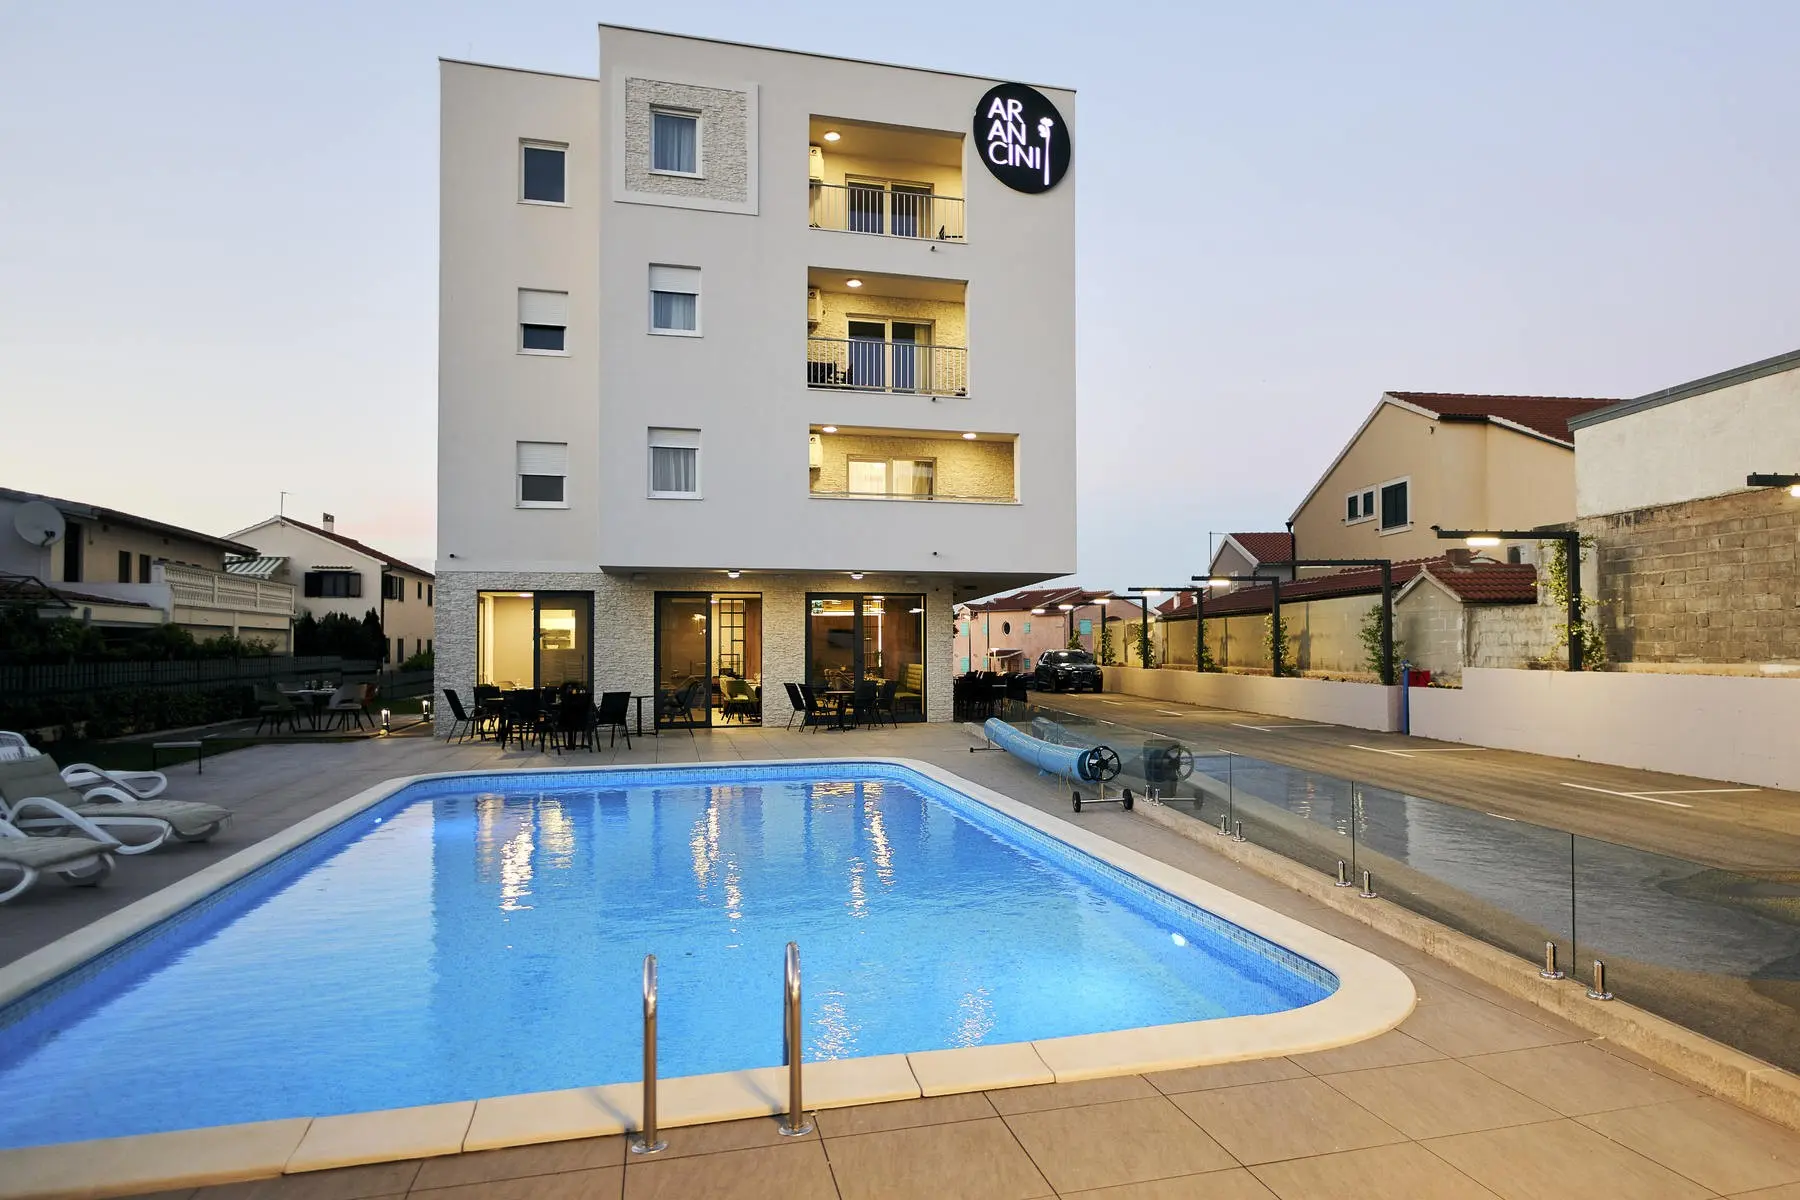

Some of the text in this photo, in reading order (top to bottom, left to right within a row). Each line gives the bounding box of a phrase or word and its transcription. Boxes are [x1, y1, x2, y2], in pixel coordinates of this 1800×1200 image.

[987, 97, 1024, 124] AR
[987, 119, 1026, 146] AN
[988, 141, 1040, 169] CINI
